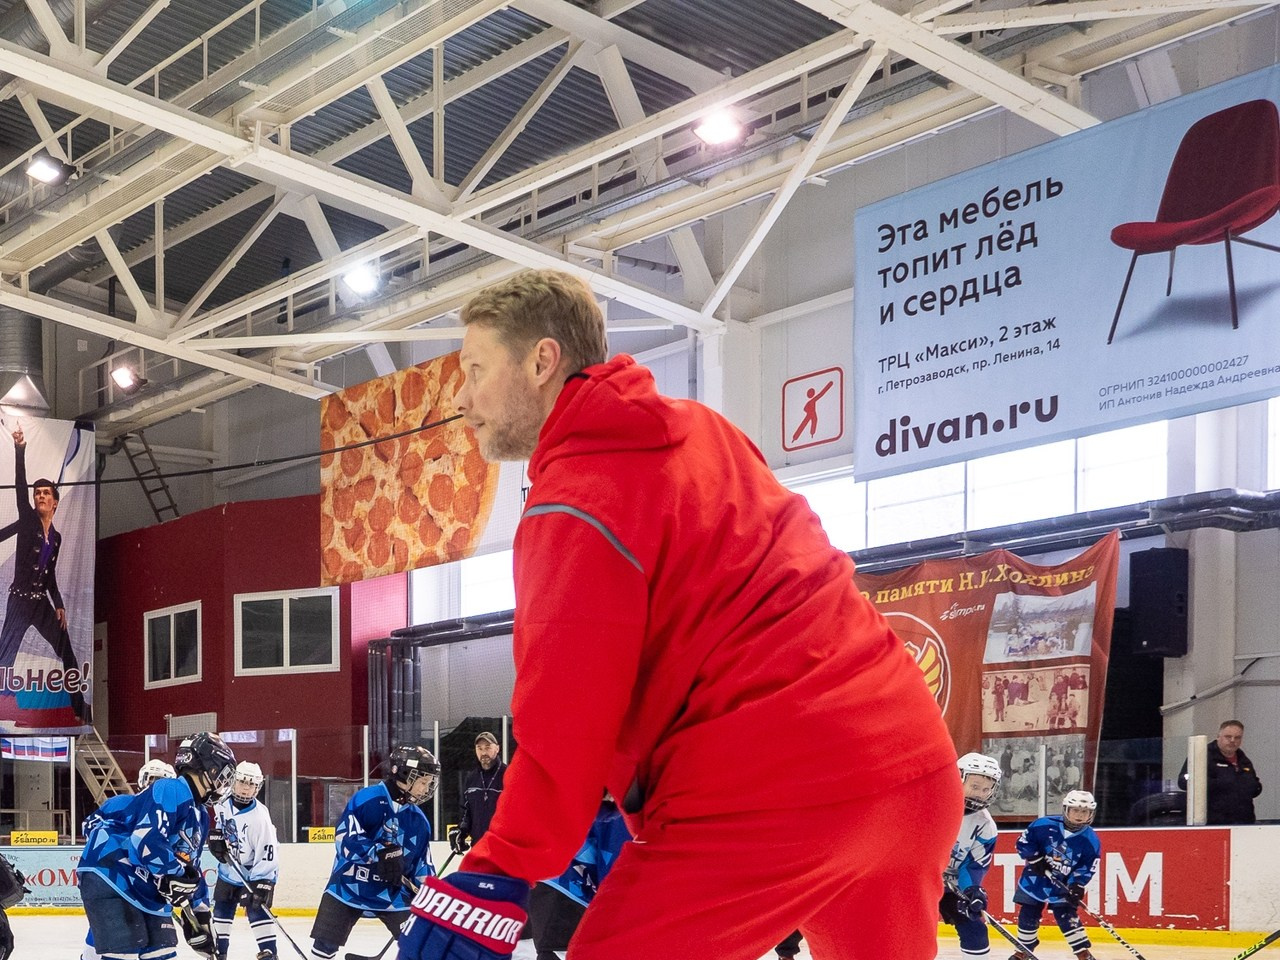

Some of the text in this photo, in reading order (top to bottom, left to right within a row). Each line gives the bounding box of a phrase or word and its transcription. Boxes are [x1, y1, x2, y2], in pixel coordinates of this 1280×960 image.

[878, 176, 1064, 253] Эта мебель
[877, 219, 1038, 289] топит лёд
[880, 265, 1022, 325] и сердца
[878, 316, 1057, 374] ТРЦ «Макси», 2 этаж
[885, 363, 970, 392] Петрозаводск,
[972, 358, 991, 371] пр.
[993, 344, 1044, 365] Ленина,
[1047, 337, 1061, 351] 14
[1099, 365, 1280, 411] ИП Антонив Надежда Андреевна
[1099, 379, 1145, 398] ОГРНИП
[875, 395, 1059, 457] divan.ru
[875, 578, 954, 604] памяти
[317, 833, 335, 842] sam
[410, 884, 525, 946] WARRIOR
